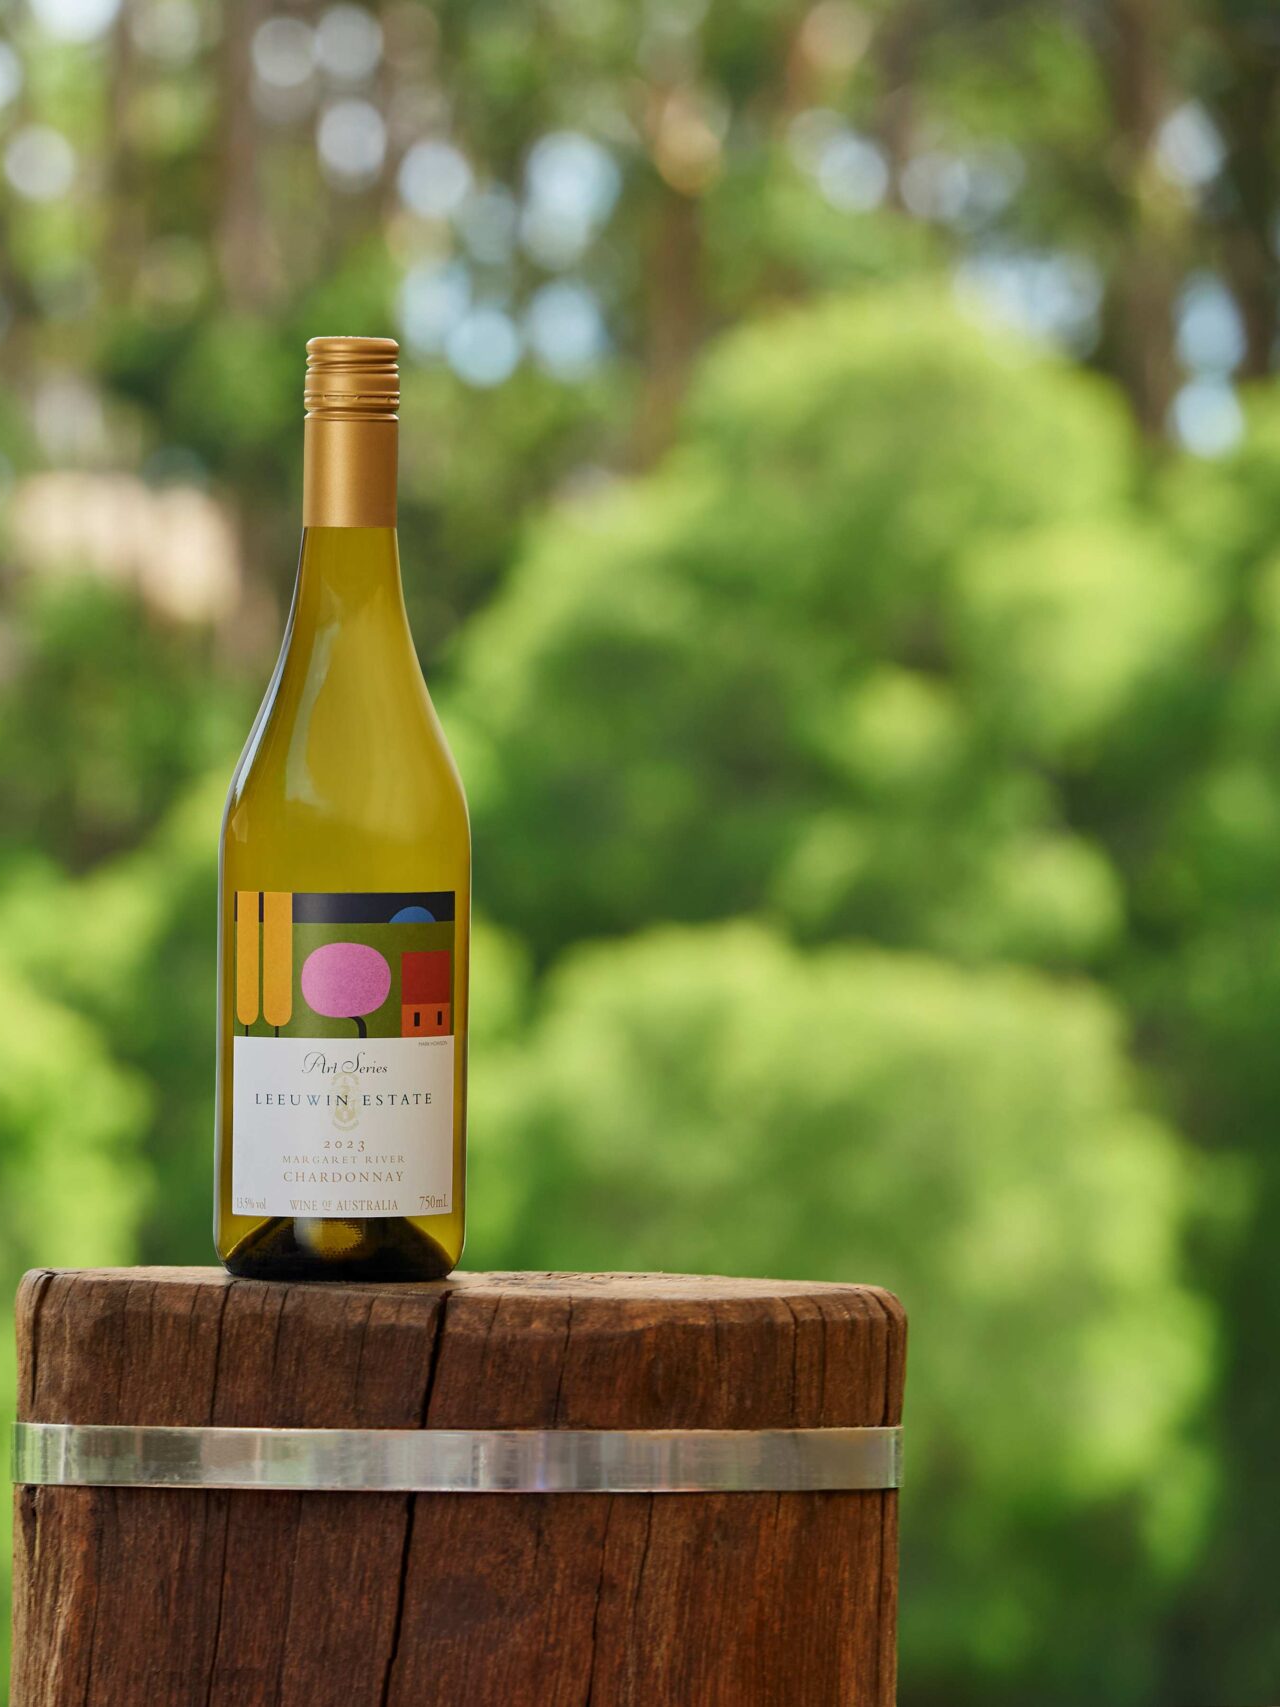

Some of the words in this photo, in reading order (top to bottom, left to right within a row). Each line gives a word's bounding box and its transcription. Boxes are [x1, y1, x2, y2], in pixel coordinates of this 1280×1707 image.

[301, 1051, 337, 1074] Art
[341, 1052, 388, 1074] Series
[255, 1093, 348, 1106] LEEUWIN
[363, 1092, 432, 1106] ESTATE
[323, 1140, 365, 1152] 2023
[282, 1155, 357, 1164] MARGARET
[365, 1155, 406, 1164] RIVER
[283, 1171, 404, 1183] CHARDONNAY
[289, 1200, 318, 1211] WINE
[336, 1200, 399, 1211] AUSTRALIA
[419, 1194, 449, 1209] 750mL
